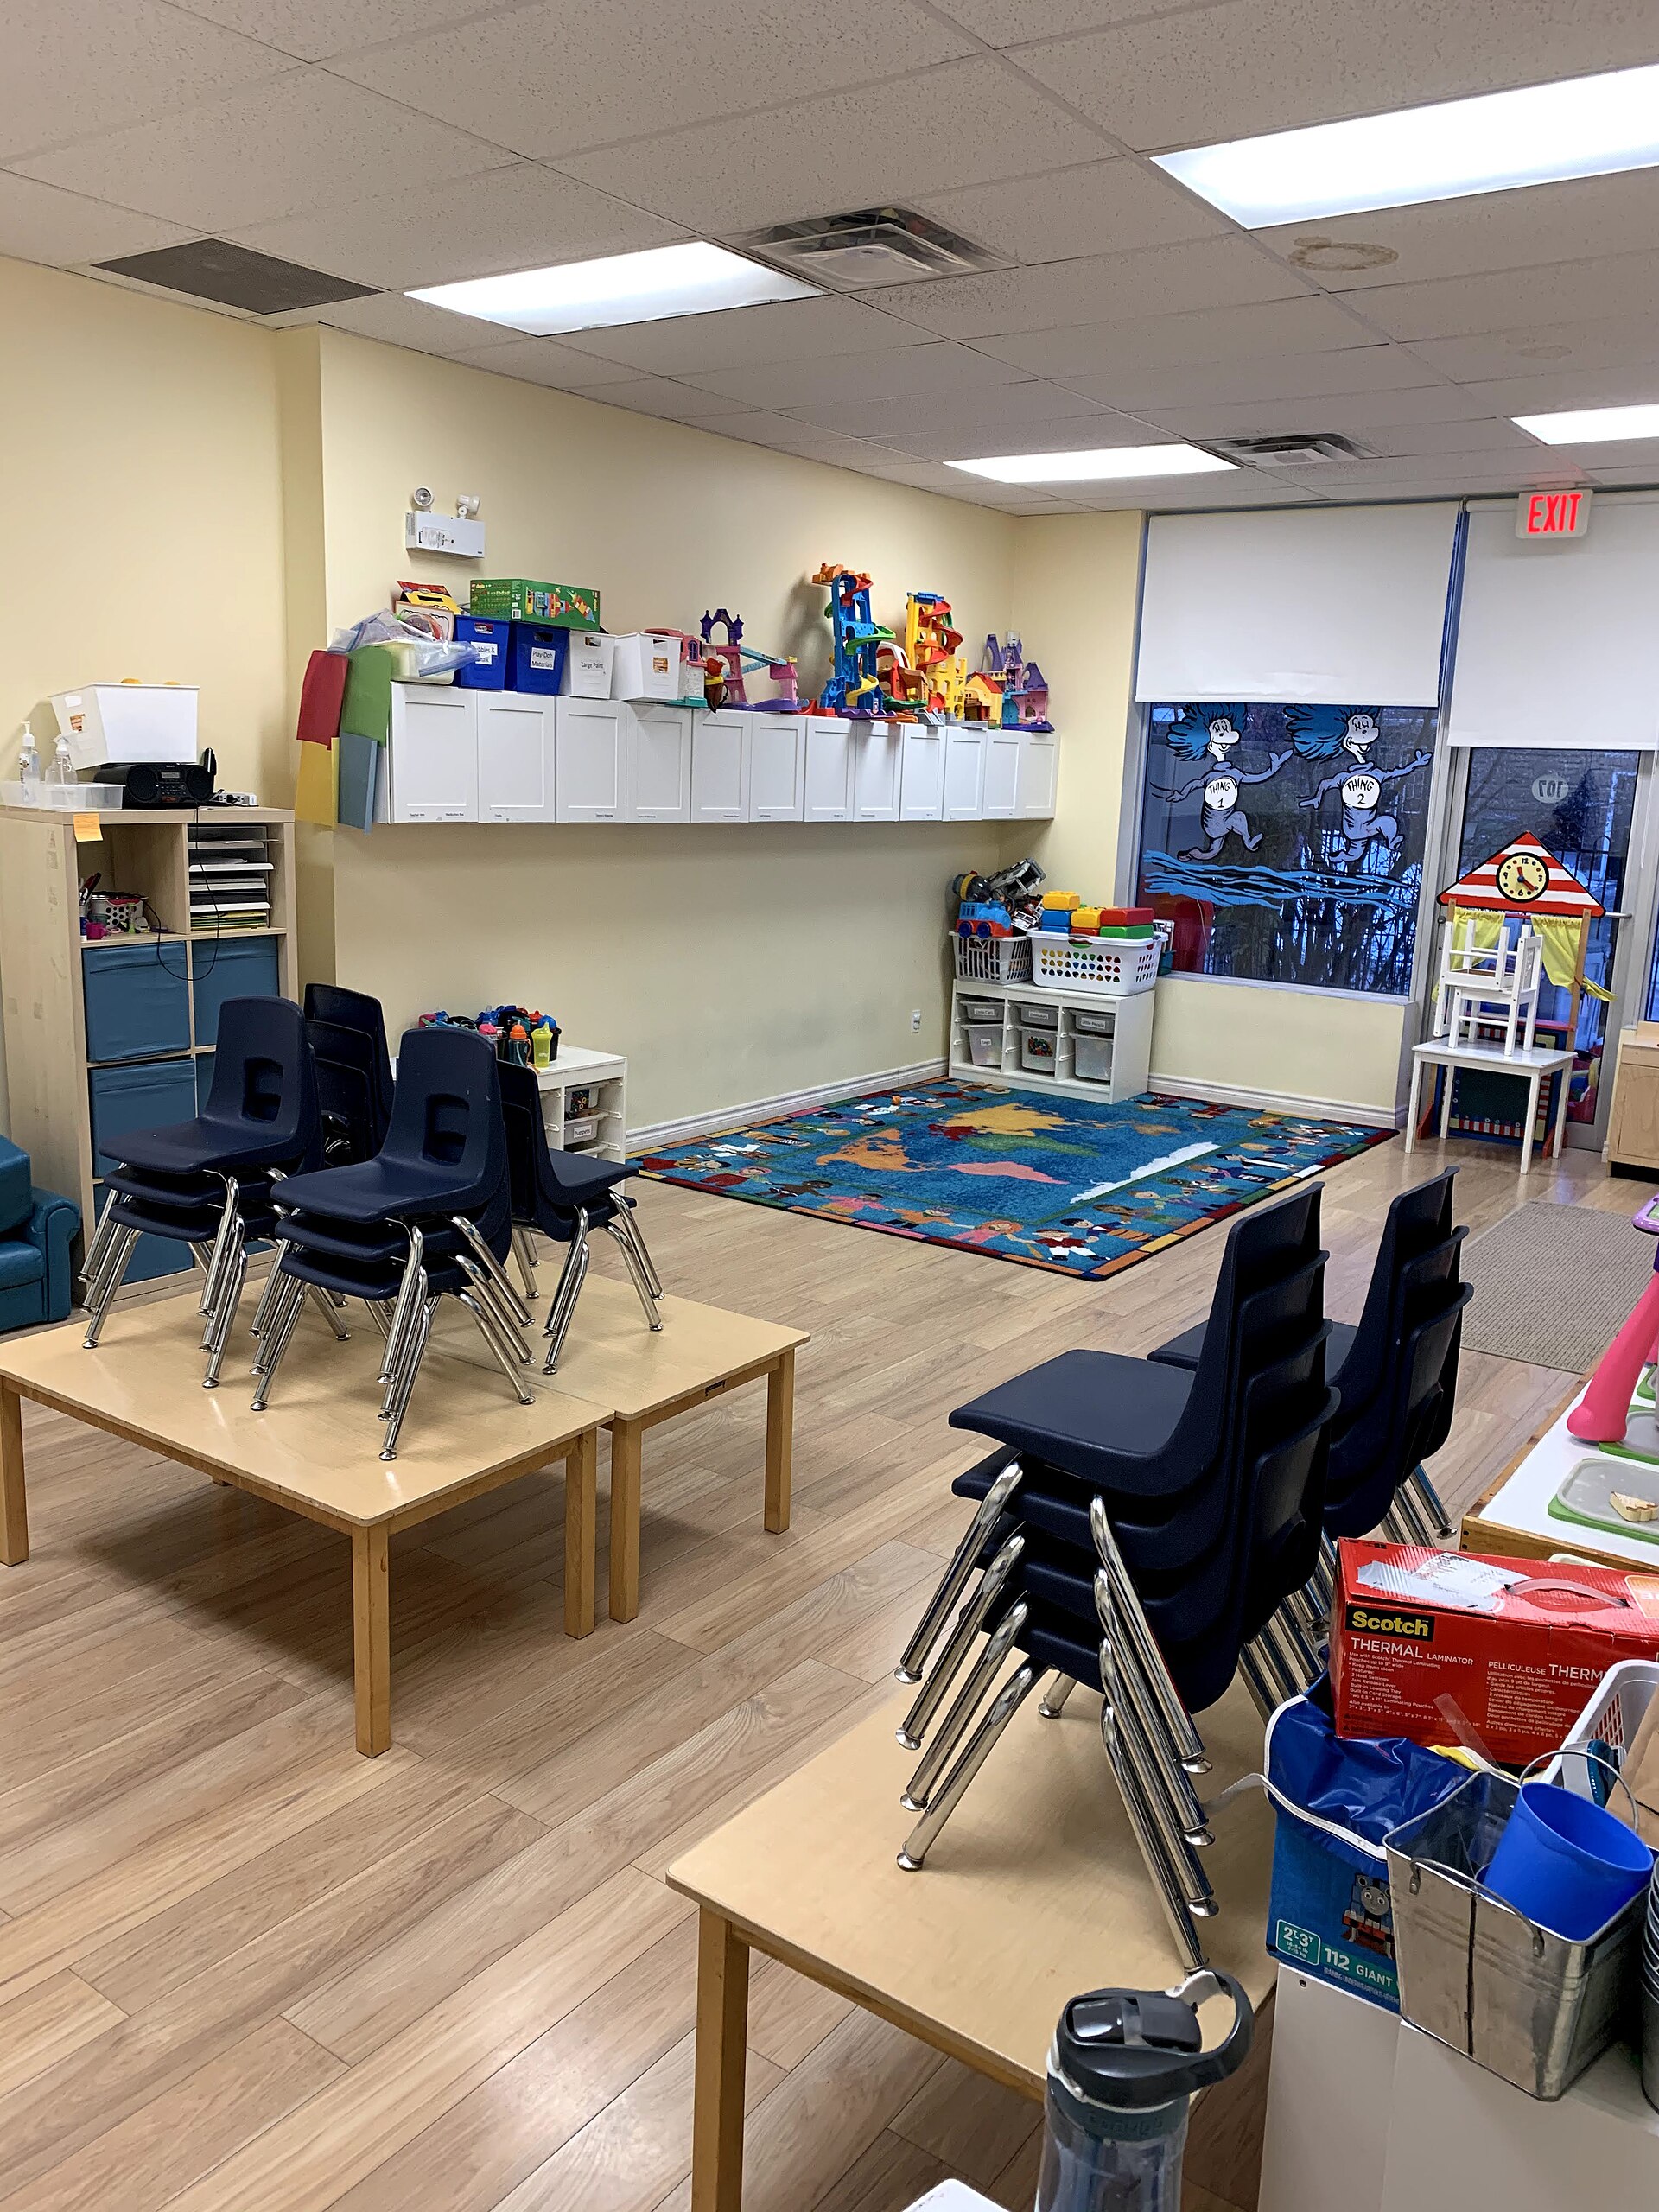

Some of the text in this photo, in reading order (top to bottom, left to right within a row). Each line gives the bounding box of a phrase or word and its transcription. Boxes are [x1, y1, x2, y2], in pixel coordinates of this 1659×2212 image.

[1528, 493, 1582, 534] EXIT
[1208, 783, 1230, 794] THING
[1346, 779, 1374, 792] THING
[1217, 798, 1224, 808] 1
[1357, 794, 1366, 805] 2
[1351, 1611, 1428, 1637] Scotch
[1351, 1637, 1474, 1666] THERMAL LAMINATOR
[1412, 1660, 1440, 1669] Laminating
[1488, 1661, 1604, 1681] PELLICULEUSE THERM
[1383, 1698, 1411, 1707] Laminating
[1325, 1948, 1393, 1987] 112 GIANT
